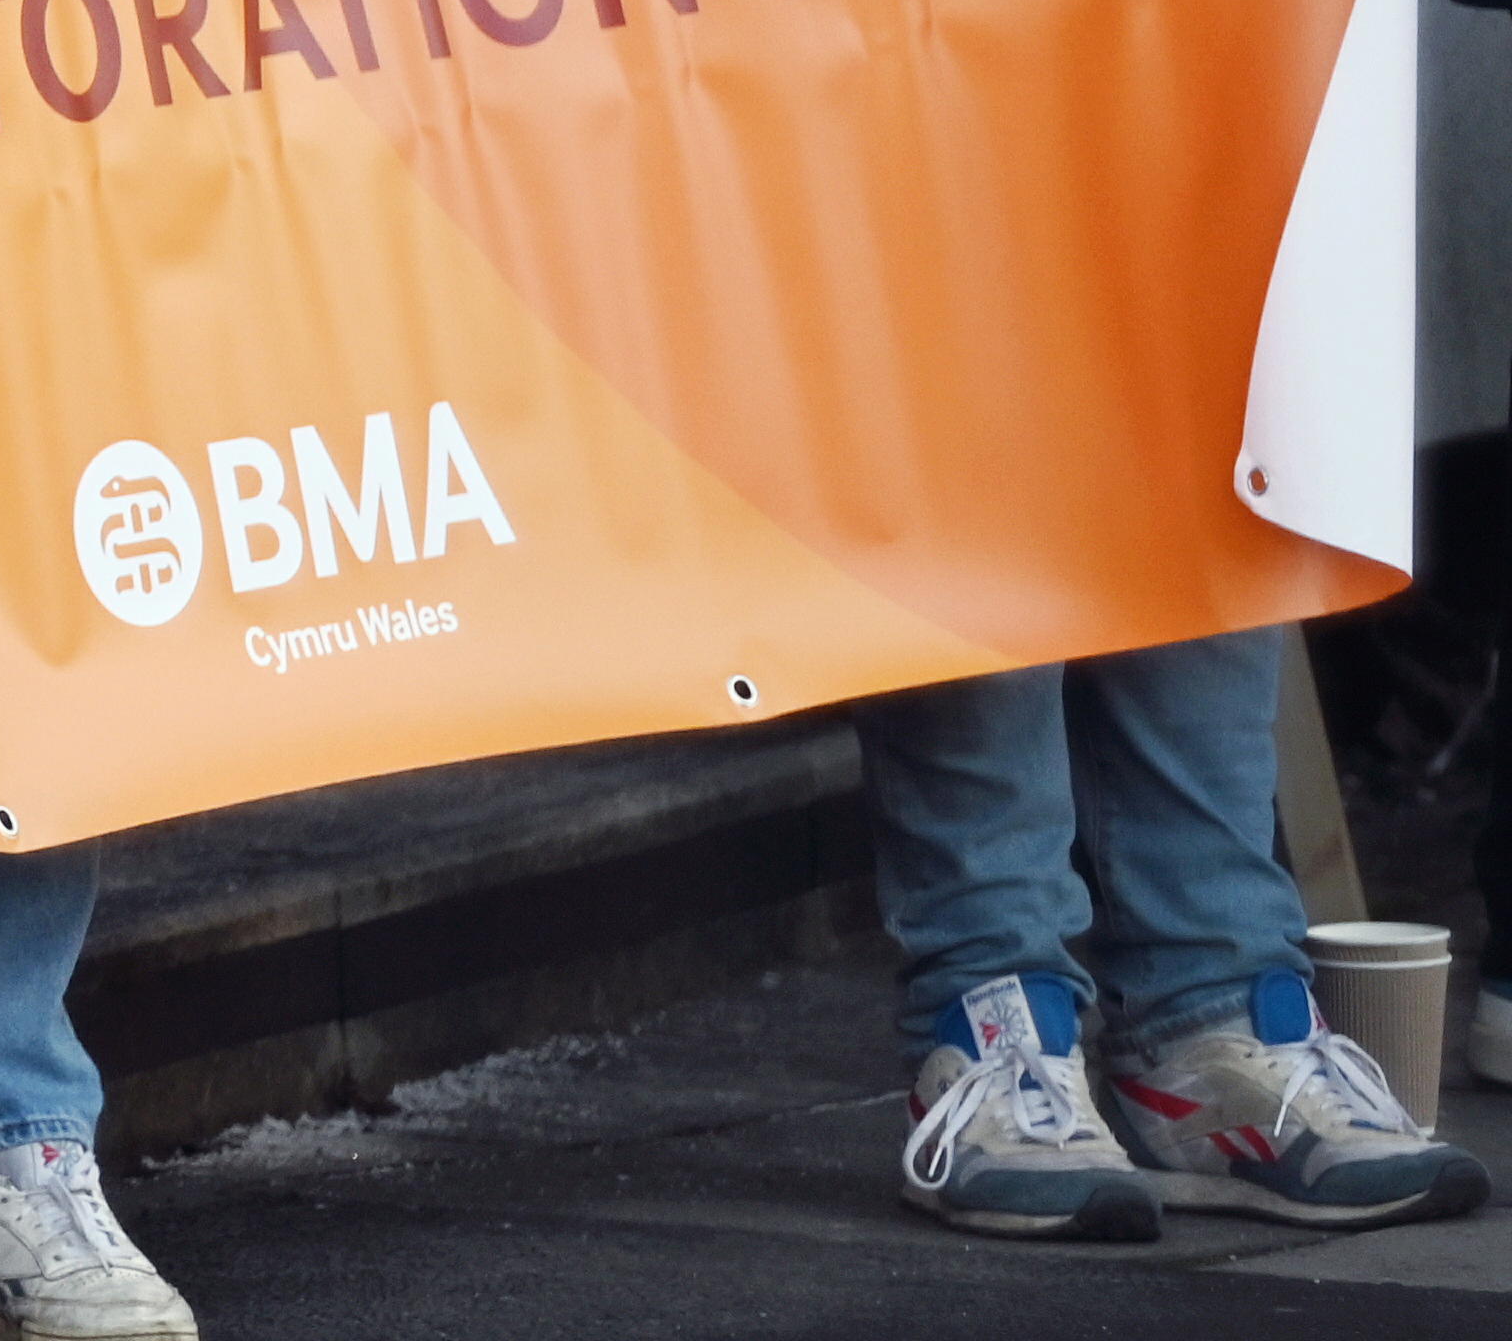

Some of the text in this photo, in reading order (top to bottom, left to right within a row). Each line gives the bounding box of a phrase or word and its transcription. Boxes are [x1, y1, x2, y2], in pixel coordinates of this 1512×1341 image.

[207, 400, 517, 594] BMA
[244, 599, 459, 675] Cymru Wales
